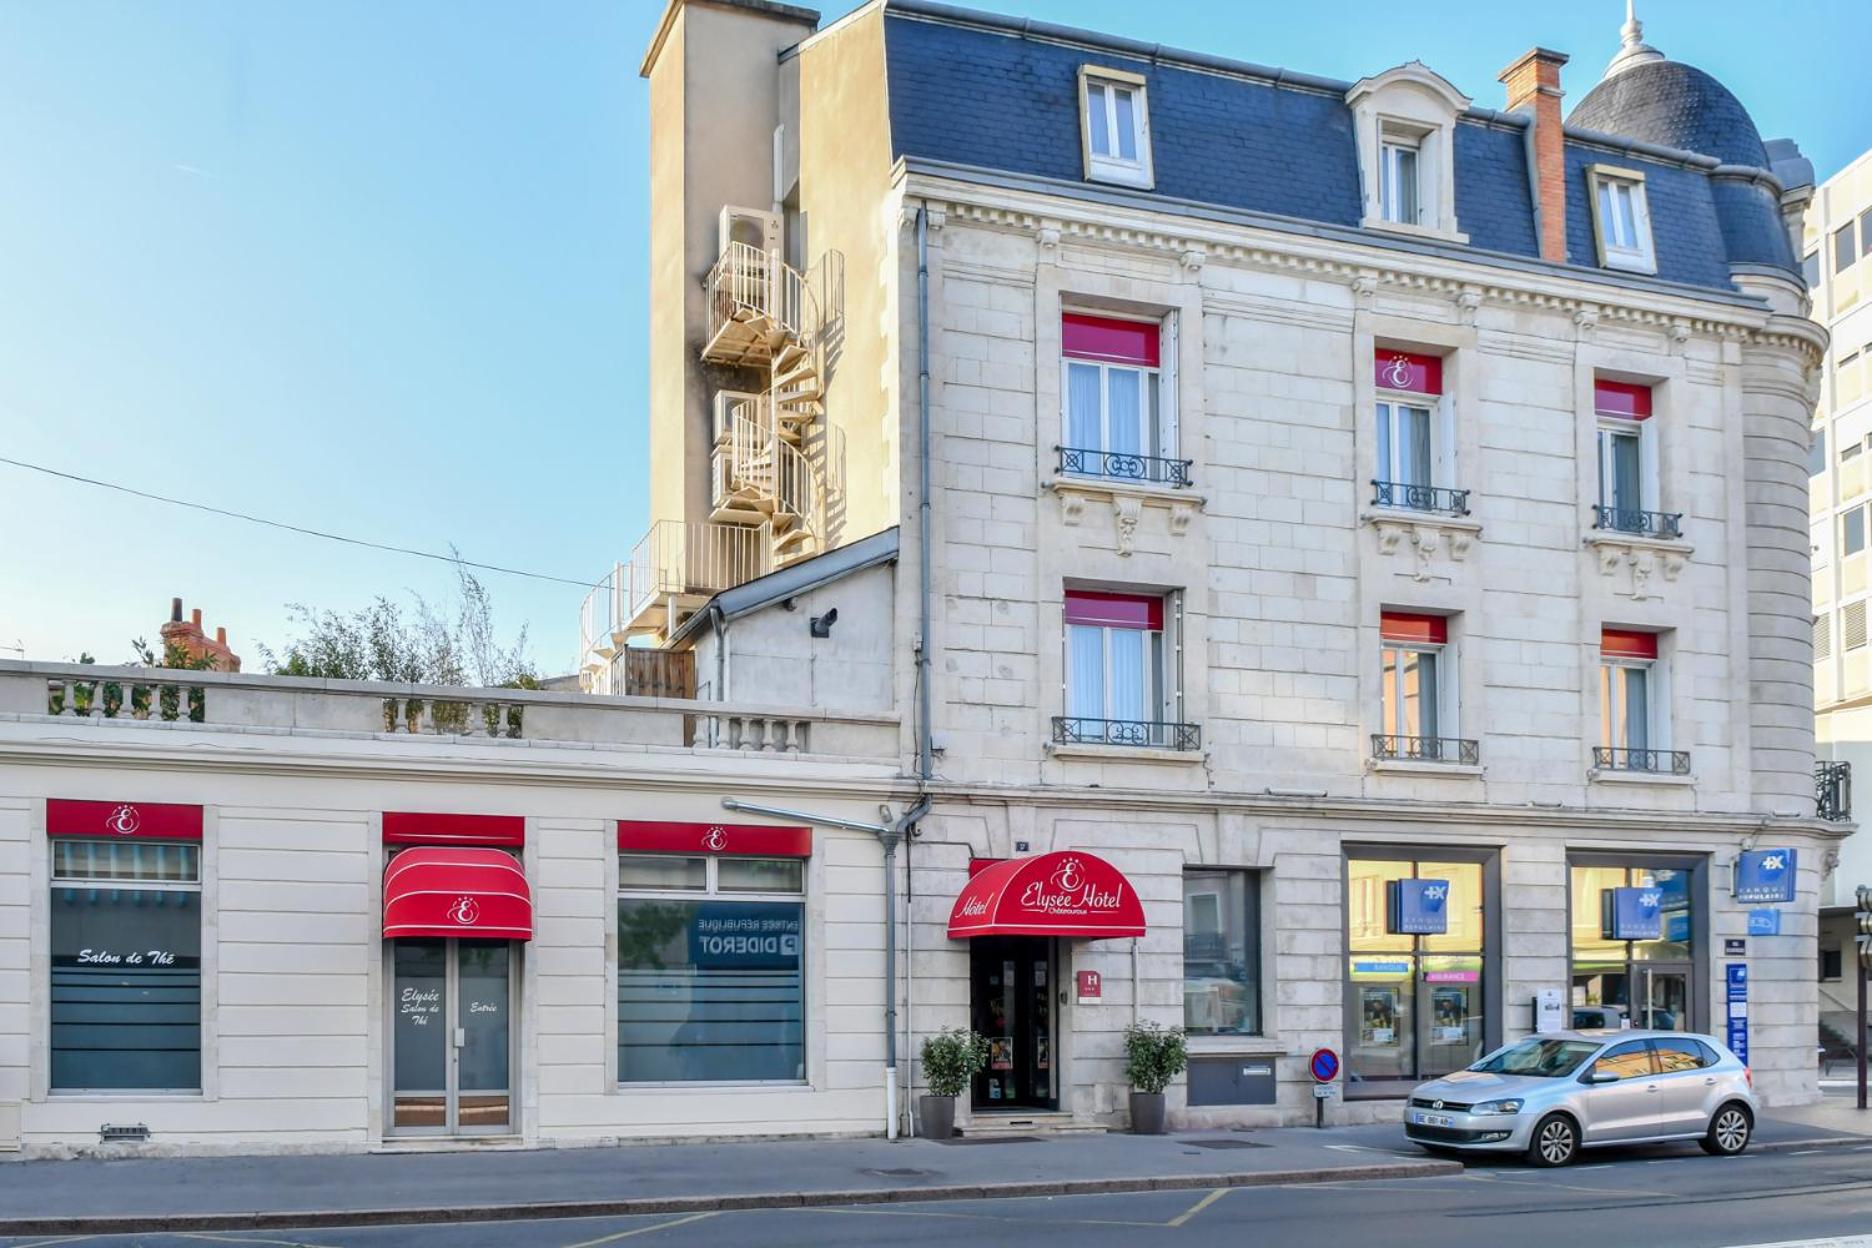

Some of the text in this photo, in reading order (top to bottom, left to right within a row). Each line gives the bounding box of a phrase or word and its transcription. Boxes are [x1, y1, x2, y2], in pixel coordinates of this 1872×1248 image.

[1021, 881, 1122, 912] Elysée Hôtel
[77, 949, 176, 965] Salon de Thé
[1087, 975, 1098, 985] H
[401, 987, 440, 1007] Elysée
[401, 1003, 440, 1013] Salon de
